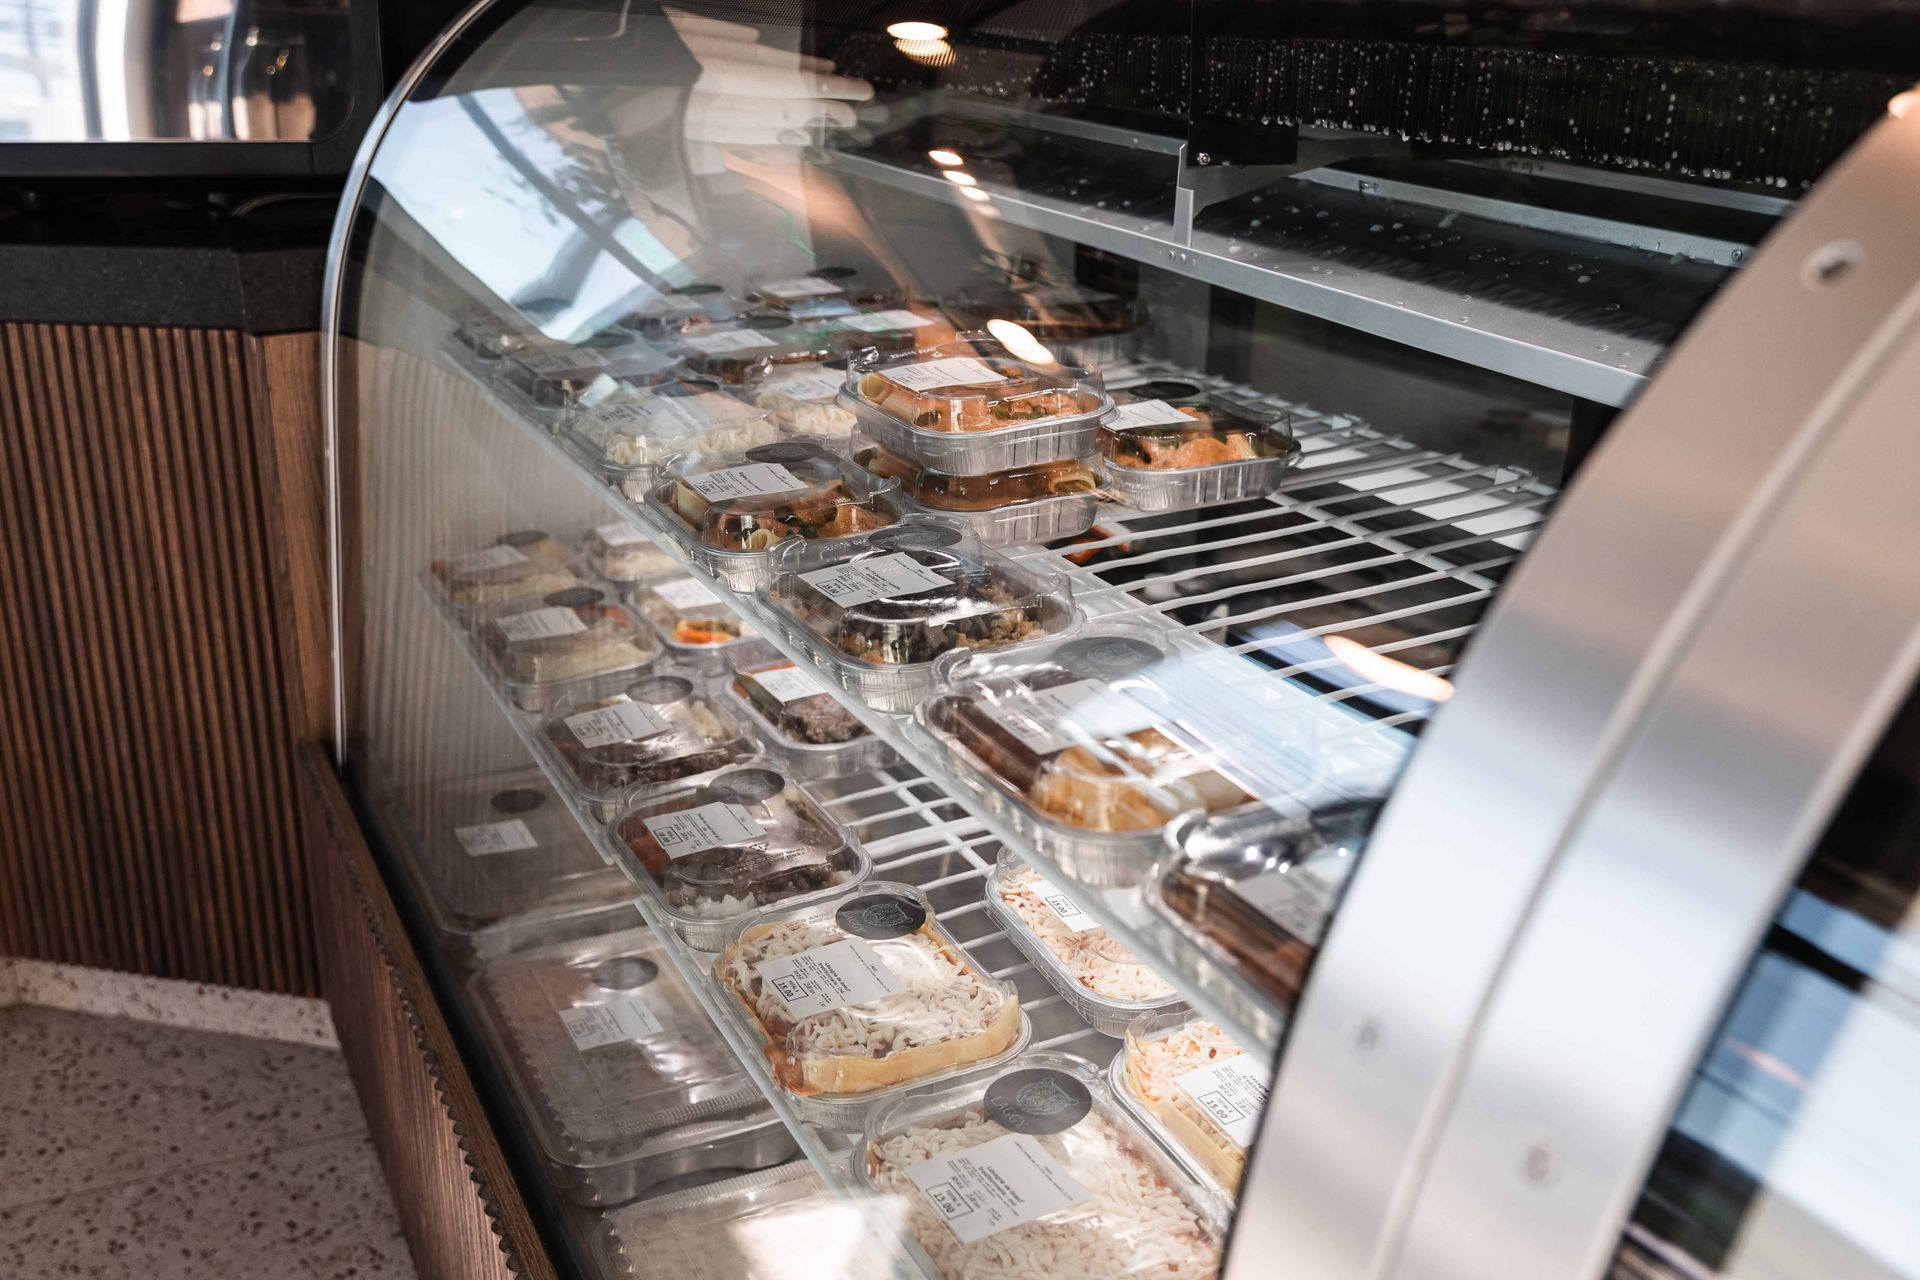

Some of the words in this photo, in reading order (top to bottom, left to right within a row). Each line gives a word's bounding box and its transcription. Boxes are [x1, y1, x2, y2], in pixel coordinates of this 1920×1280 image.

[1051, 900, 1068, 913] 15.00
[778, 982, 794, 997] 15.00
[989, 1095, 1031, 1129] LAGGY
[1206, 1100, 1228, 1119] 15.00
[933, 1192, 955, 1213] 15.00
